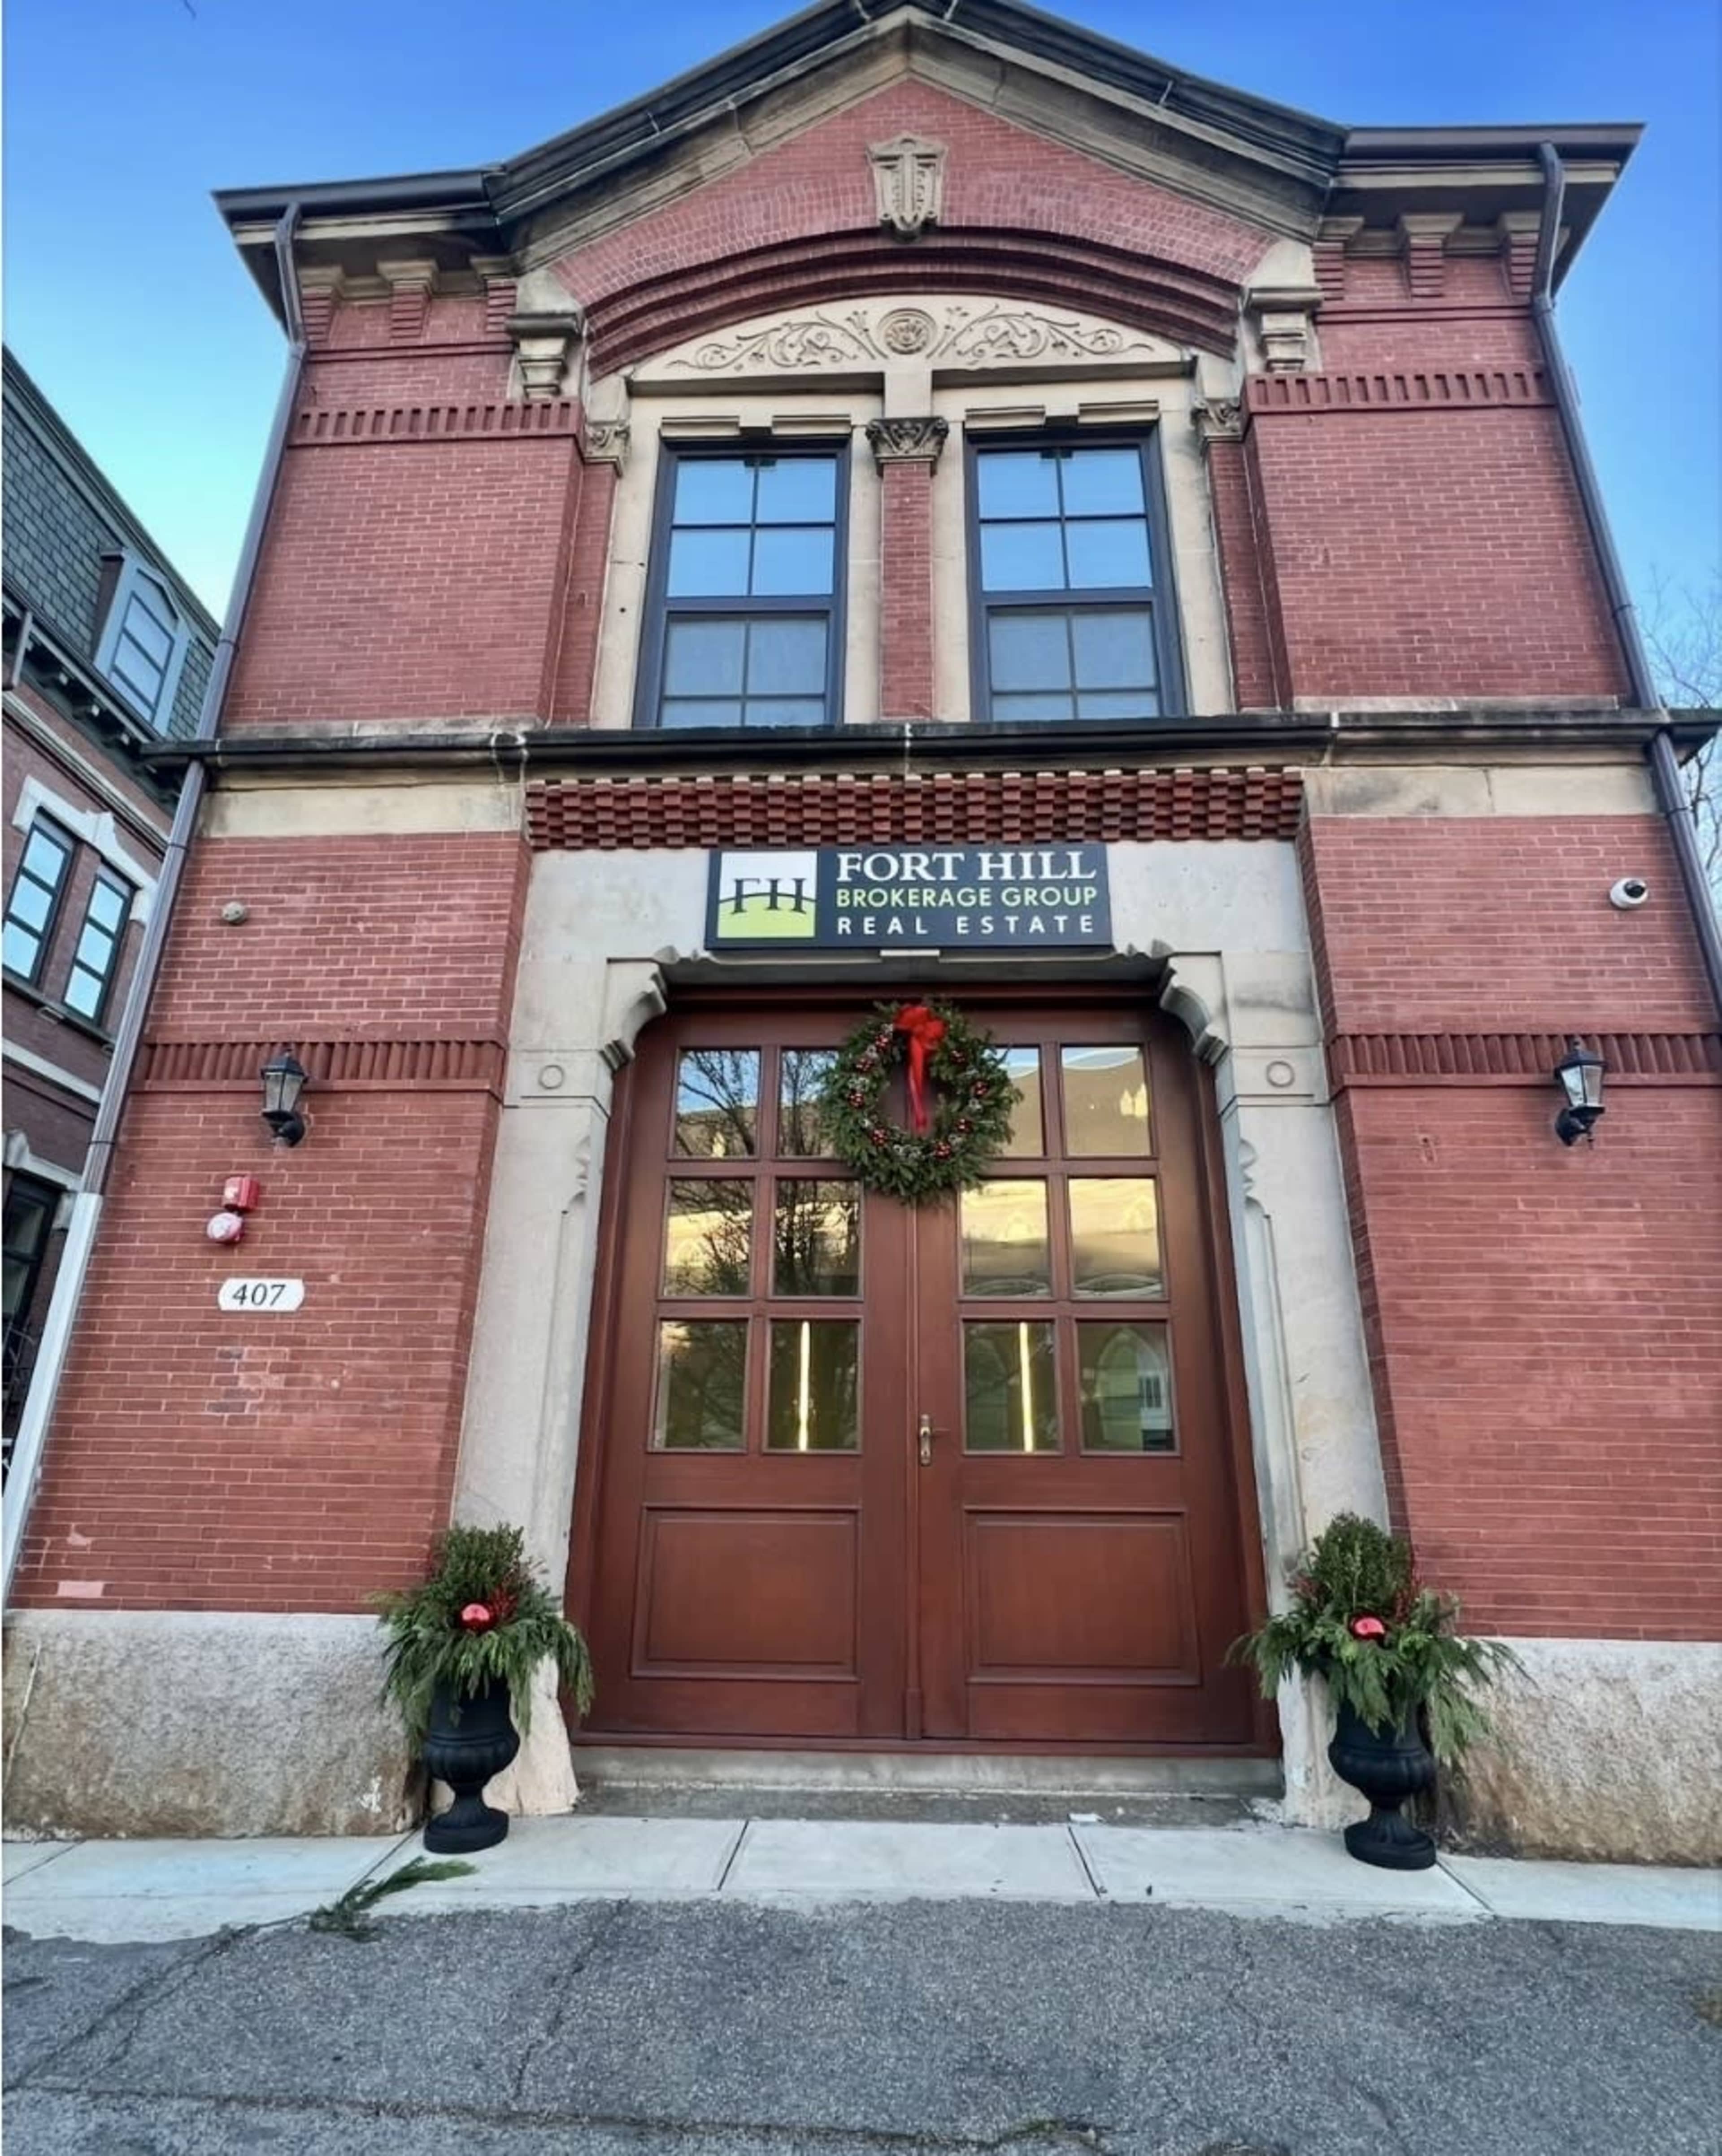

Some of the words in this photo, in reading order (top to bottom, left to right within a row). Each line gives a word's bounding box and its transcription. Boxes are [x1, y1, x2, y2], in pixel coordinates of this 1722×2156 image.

[837, 852, 965, 882] FORT
[978, 851, 1096, 881] HILL
[837, 888, 992, 908] BROKERAGE
[1001, 886, 1098, 906] GROUP
[837, 916, 928, 935] REAL
[957, 915, 1094, 934] ESTATE
[232, 1283, 287, 1307] 407
